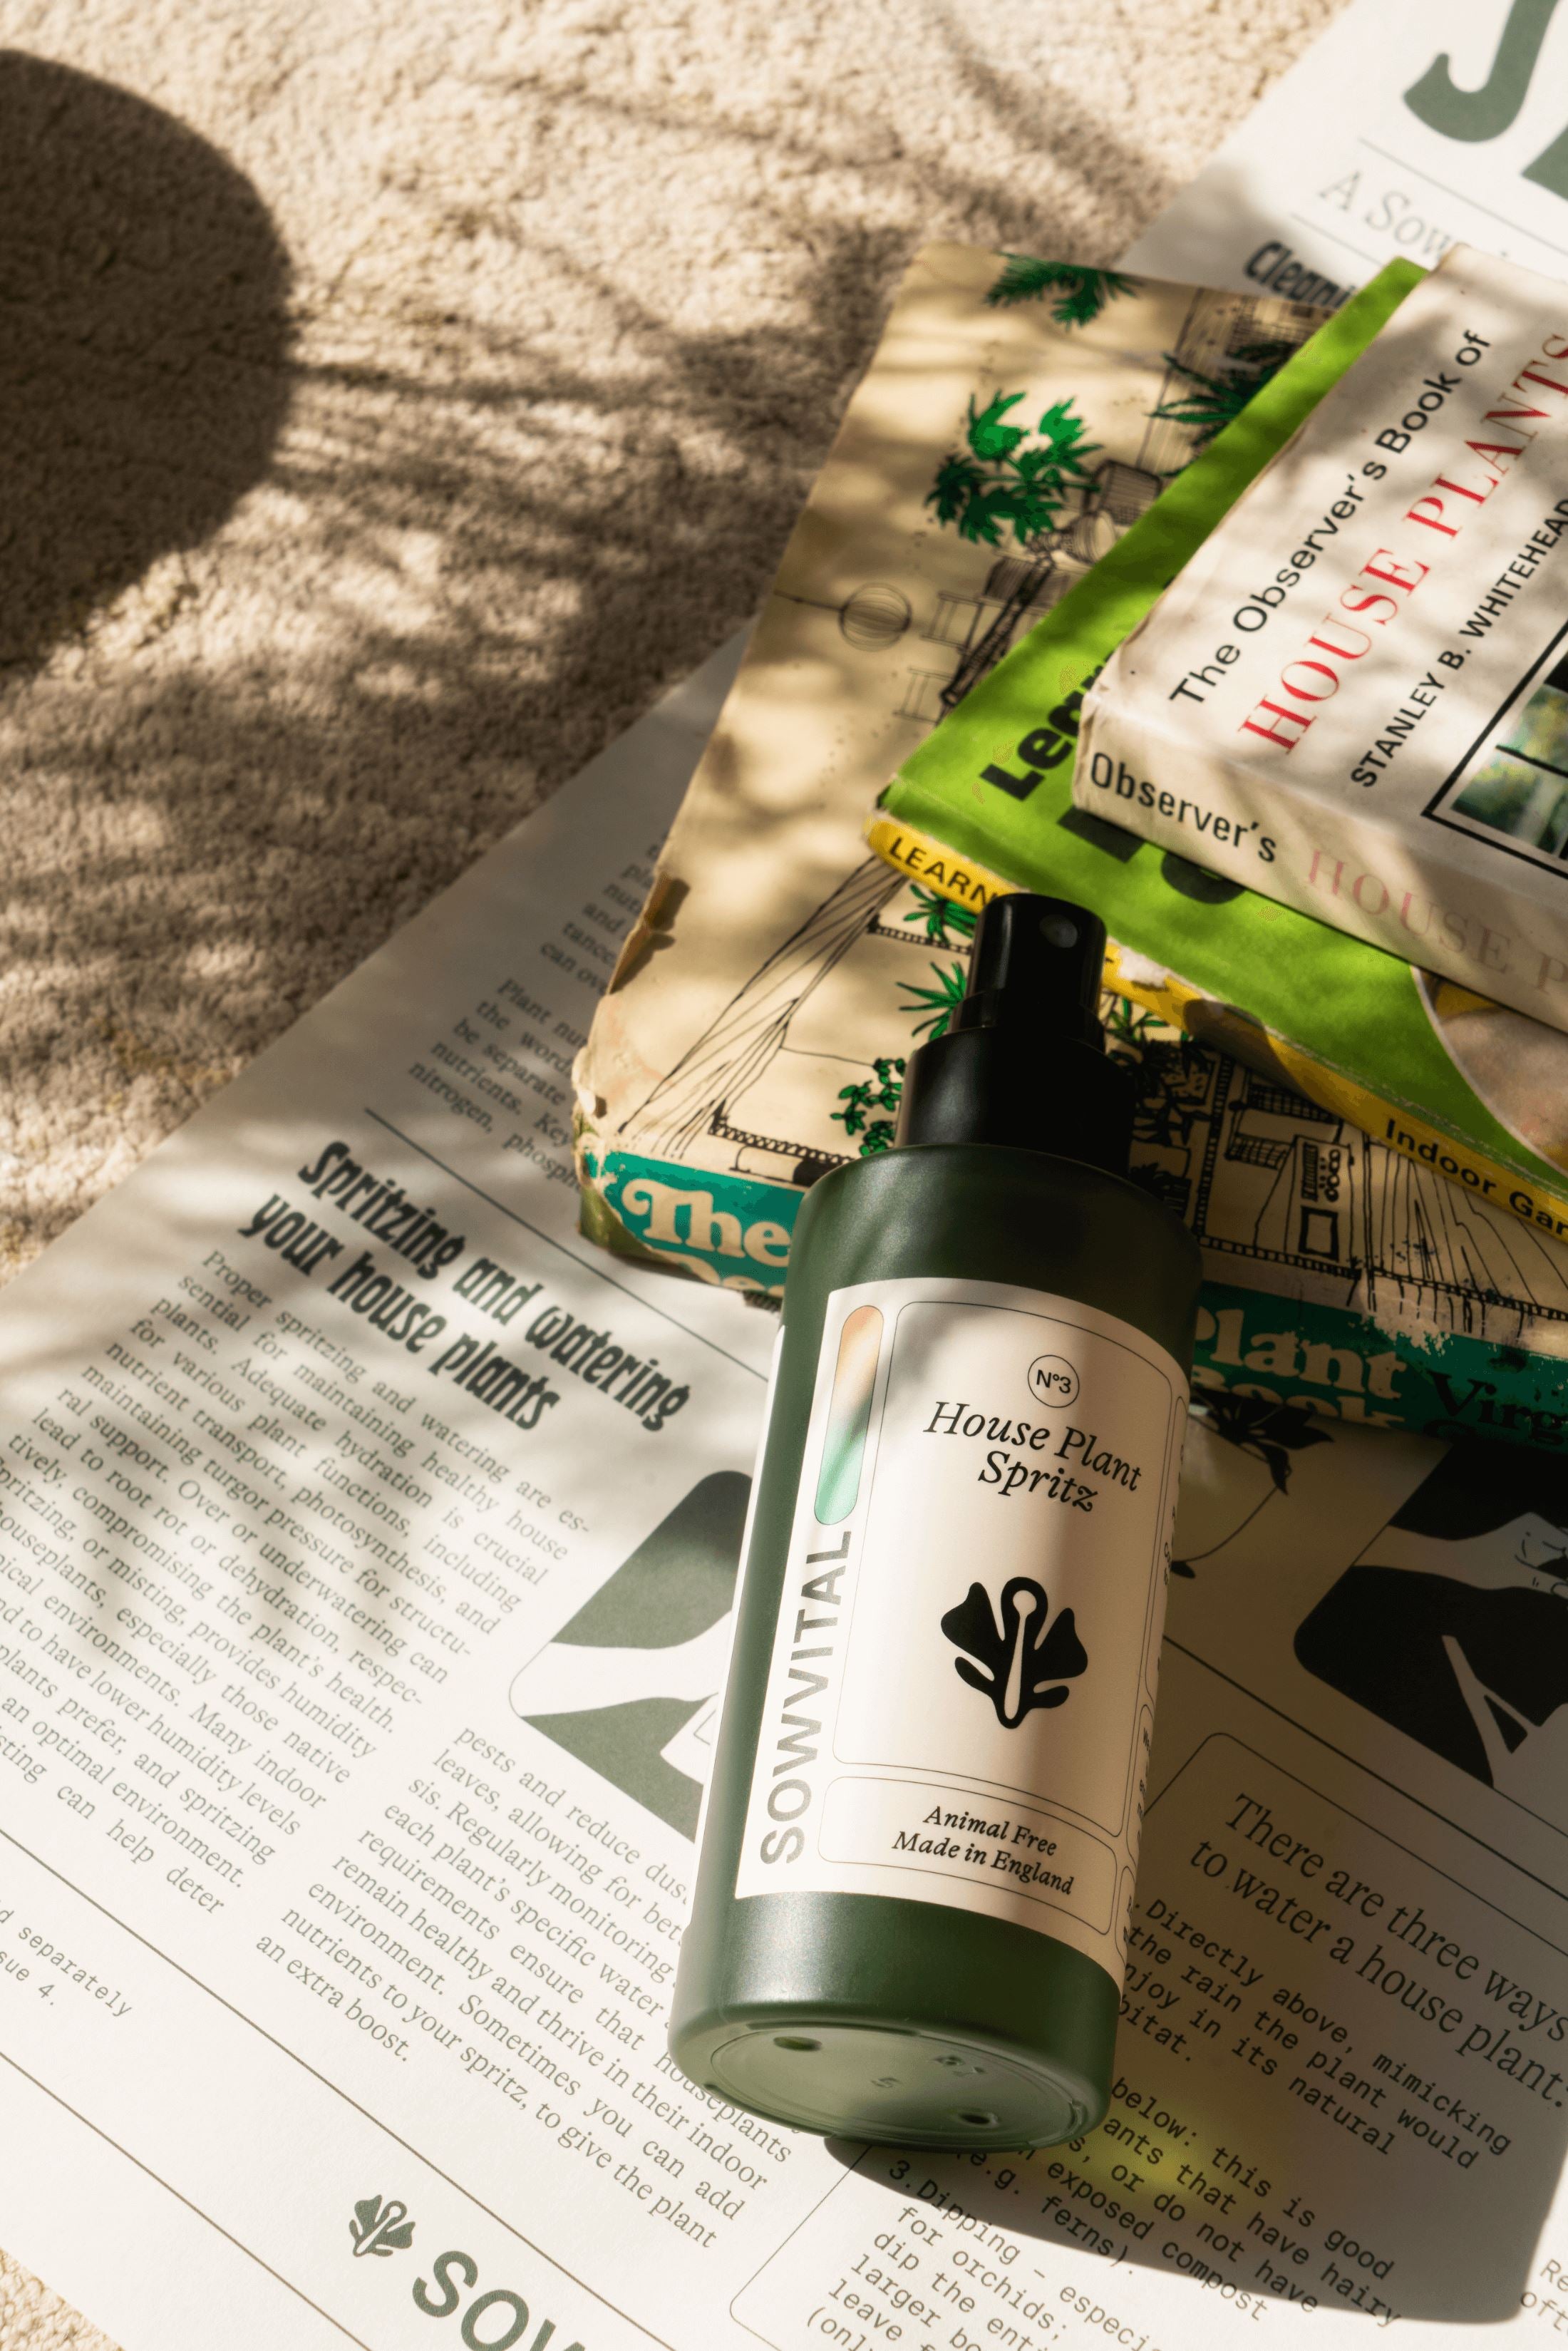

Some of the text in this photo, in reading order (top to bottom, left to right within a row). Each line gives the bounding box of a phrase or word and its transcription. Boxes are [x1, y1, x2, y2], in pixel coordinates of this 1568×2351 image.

[1319, 171, 1361, 211] A
[1170, 640, 1242, 707] The
[1375, 372, 1461, 455] Book
[1455, 329, 1491, 367] of
[1238, 548, 1430, 755] HOUSE
[1351, 672, 1445, 788] STANLEY
[1438, 647, 1472, 671] B.
[1307, 848, 1510, 974] HOUSE
[621, 1178, 791, 1267] The
[1386, 1118, 1497, 1193] Indoor
[237, 1195, 561, 1430] your house plants
[297, 1141, 695, 1434] Spritzing and watering
[201, 1250, 590, 1533] Proper spritzing and watering are es-
[923, 1401, 1142, 1491] House Plant
[978, 1451, 1098, 1512] Spritz
[56, 1388, 448, 1685] ral support. Over or underwatering can
[103, 1340, 502, 1635] nutrient transport, photosynthesis, and
[8, 1434, 68, 1489] tively,
[71, 1486, 215, 1601] compromising
[216, 1594, 252, 1626] the
[324, 1671, 393, 1734] health.
[43, 1595, 328, 1809] environments. Many indoor
[55, 1697, 277, 1866] prefer, and spritzing
[760, 1531, 852, 1865] SOWVITAL
[1, 1697, 244, 1889] an optimal environment.
[407, 1778, 674, 1985] sis. Regularly monitoring
[432, 1748, 643, 1910] leaves, allowing for
[453, 1727, 641, 1865] pests and reduce
[892, 1831, 1075, 1895] Made in England
[923, 1806, 1058, 1856] Animal Free
[19, 1927, 133, 2017] separately
[38, 1984, 55, 2005] 4.
[255, 1935, 410, 2063] an extra boost.
[356, 1829, 646, 2052] requirements ensure that
[383, 1804, 435, 1848] each
[510, 1899, 597, 1967] specific
[599, 1962, 664, 2017] water
[1189, 1840, 1229, 1878] to
[1232, 1868, 1332, 1944] water
[1329, 1935, 1356, 1966] a
[1354, 1943, 1464, 2034] house
[1224, 1792, 1568, 2042] There are three ways
[280, 1908, 718, 2248] nutrients to your spritz, to give the plant
[307, 1883, 746, 2221] environment. Sometimes you can add
[331, 1855, 768, 2191] remain healthy and thrive in their indoor
[1128, 1926, 1480, 2171] the rain the plant would
[1134, 1898, 1512, 2157] .Directly above, mimicking
[1187, 2007, 1396, 2156] in its natural
[1041, 2196, 1133, 2274] ferns).
[1047, 2162, 1267, 2320] exposed compost
[1103, 2118, 1401, 2327] ants that have hairy
[1110, 2164, 1318, 2313] or do not have
[1111, 2076, 1396, 2281] below: this is good
[827, 2277, 903, 2342] leave
[850, 2252, 942, 2329] larger
[873, 2233, 976, 2314] dip the
[897, 2206, 1067, 2342] for orchids;
